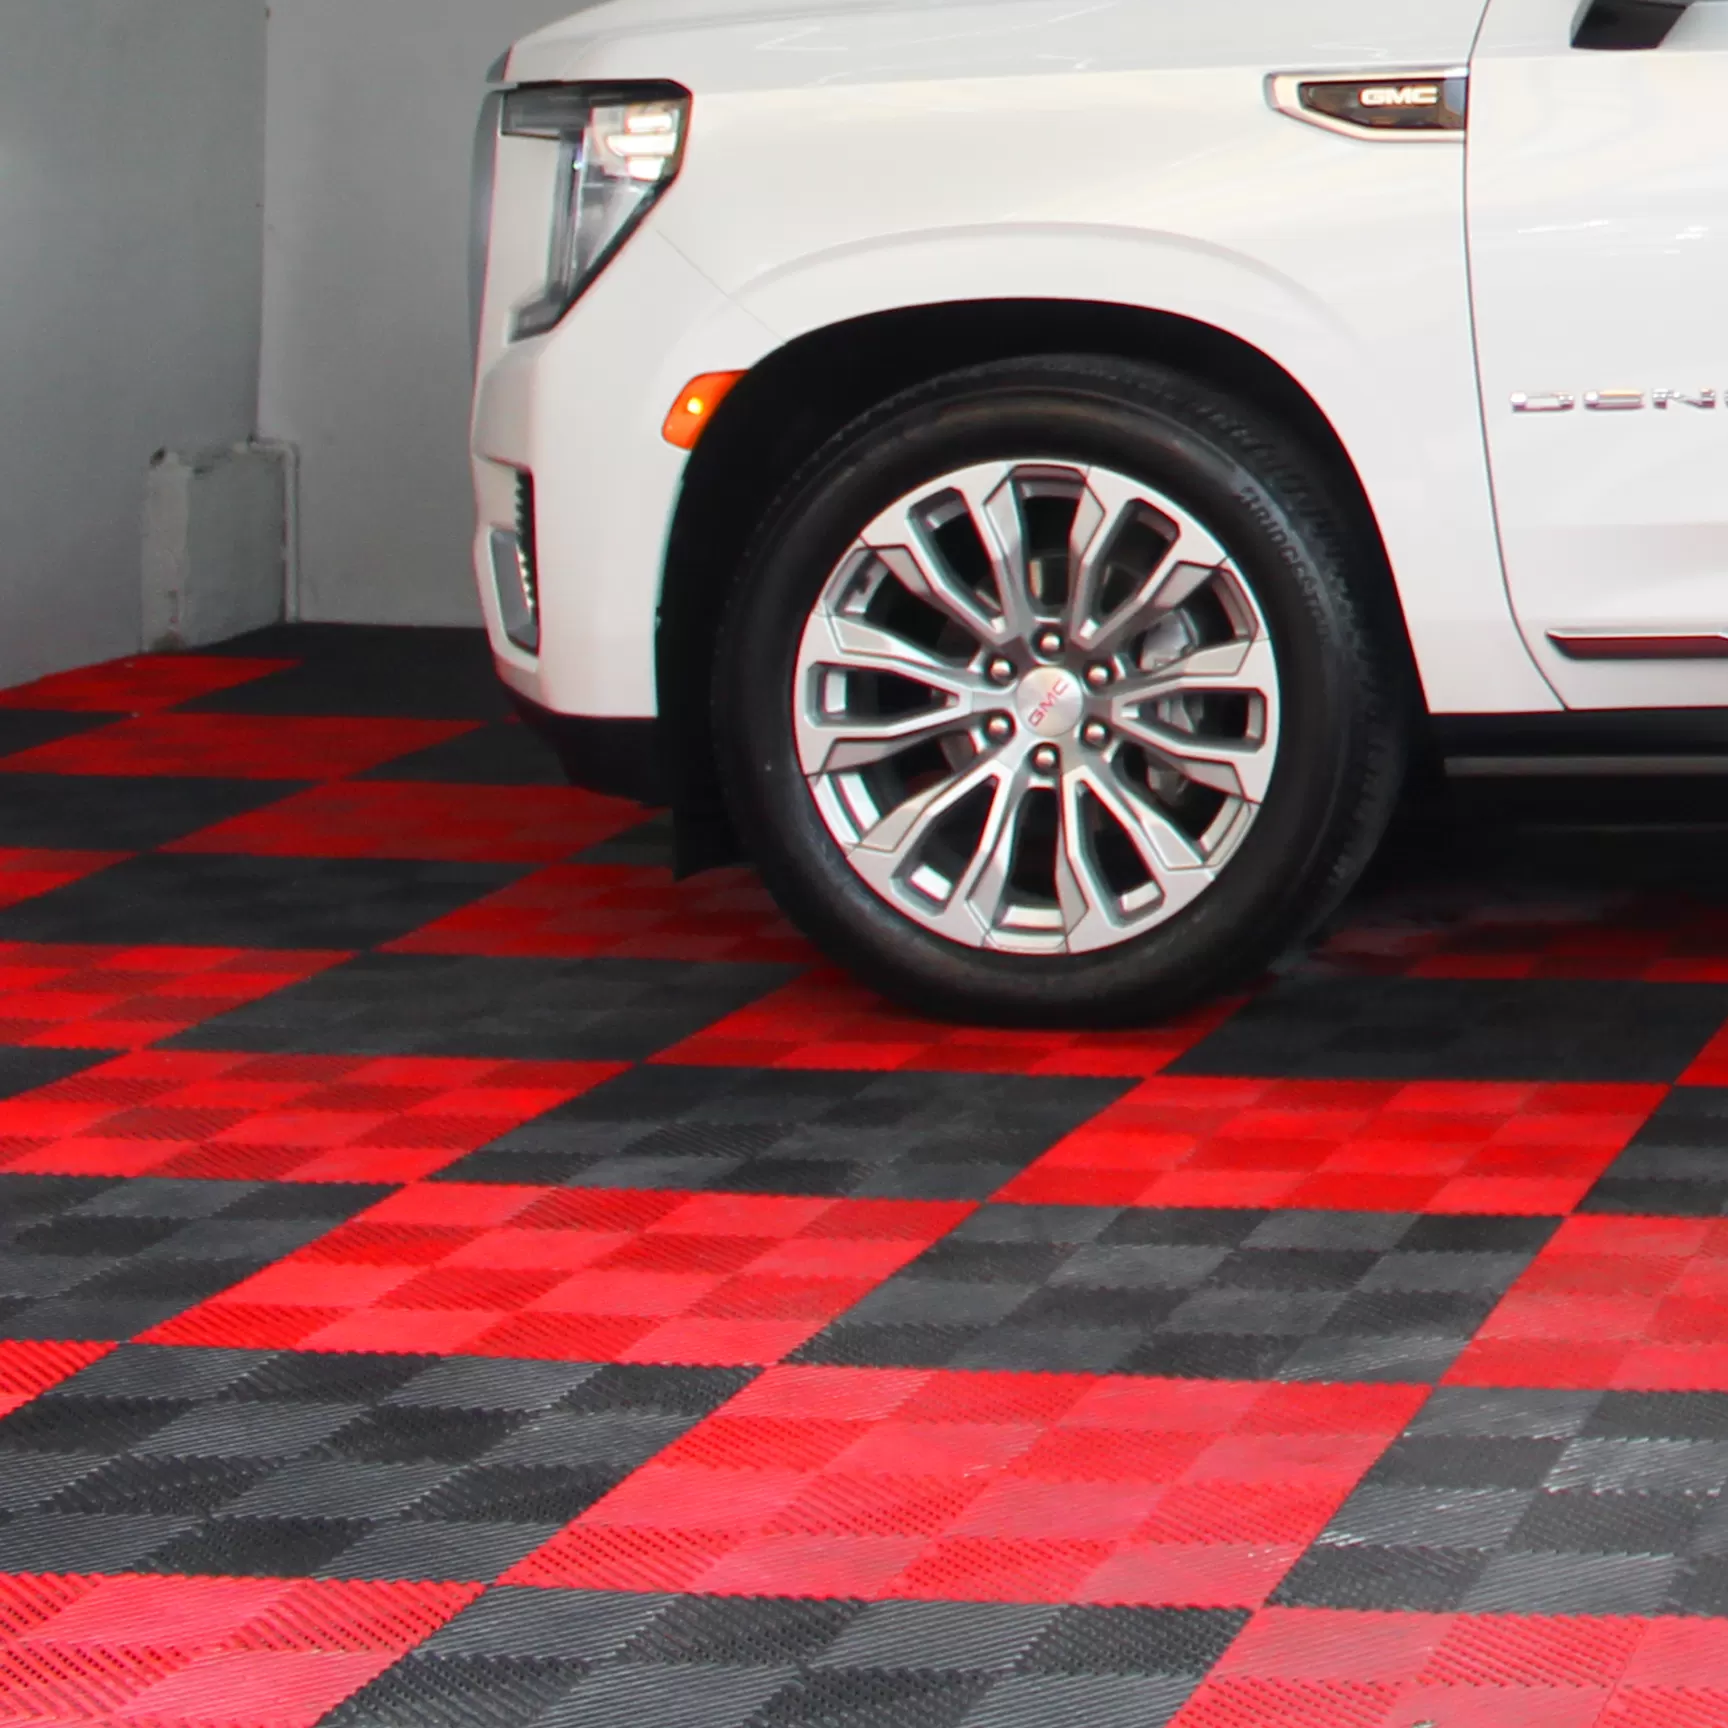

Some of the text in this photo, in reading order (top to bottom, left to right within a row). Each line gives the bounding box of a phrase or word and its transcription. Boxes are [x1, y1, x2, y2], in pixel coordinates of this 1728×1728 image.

[1360, 85, 1438, 106] GMC
[1236, 484, 1333, 644] BRIDGESTO
[1027, 677, 1070, 727] GMC
